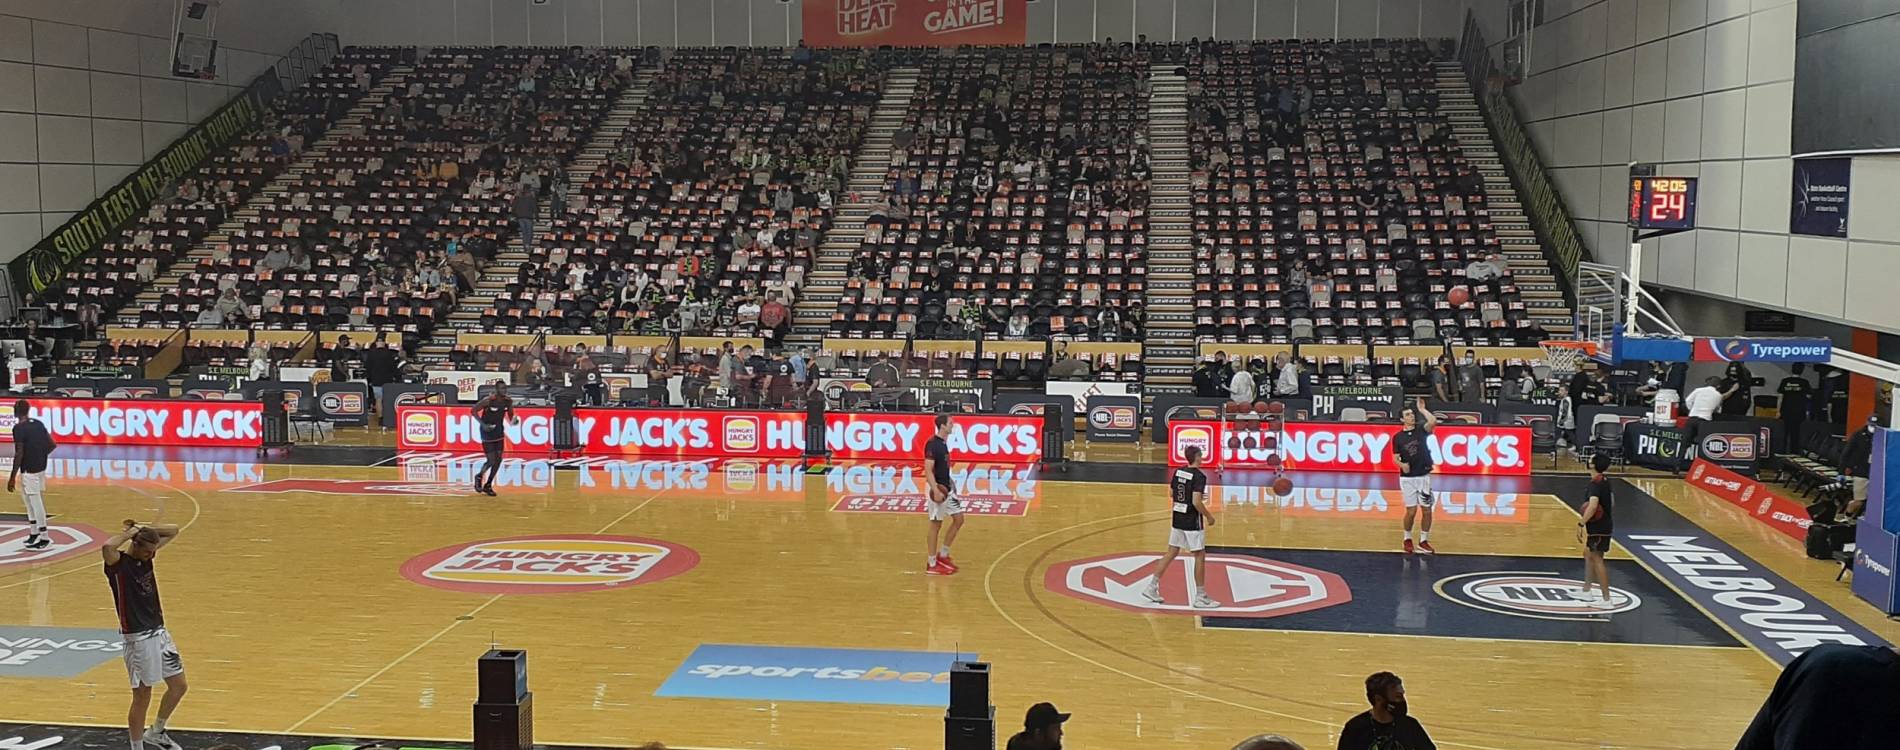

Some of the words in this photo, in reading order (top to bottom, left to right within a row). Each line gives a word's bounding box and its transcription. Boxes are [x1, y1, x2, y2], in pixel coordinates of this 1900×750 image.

[838, 5, 896, 35] HEAT
[924, 0, 1004, 32] GAME!
[1652, 194, 1685, 220] 24
[54, 208, 107, 264] SOUTH
[102, 182, 141, 227] EAST
[1752, 343, 1827, 359] Tyrepower
[458, 378, 476, 386] DEEP
[458, 385, 475, 393] HEAT
[932, 380, 973, 388] MELBOURNE
[1338, 387, 1382, 396] MELBOURNE
[462, 550, 654, 563] HUNGRY
[444, 559, 640, 574] JACK'S
[1864, 554, 1891, 577] Tyrepower
[1499, 586, 1582, 602] NB
